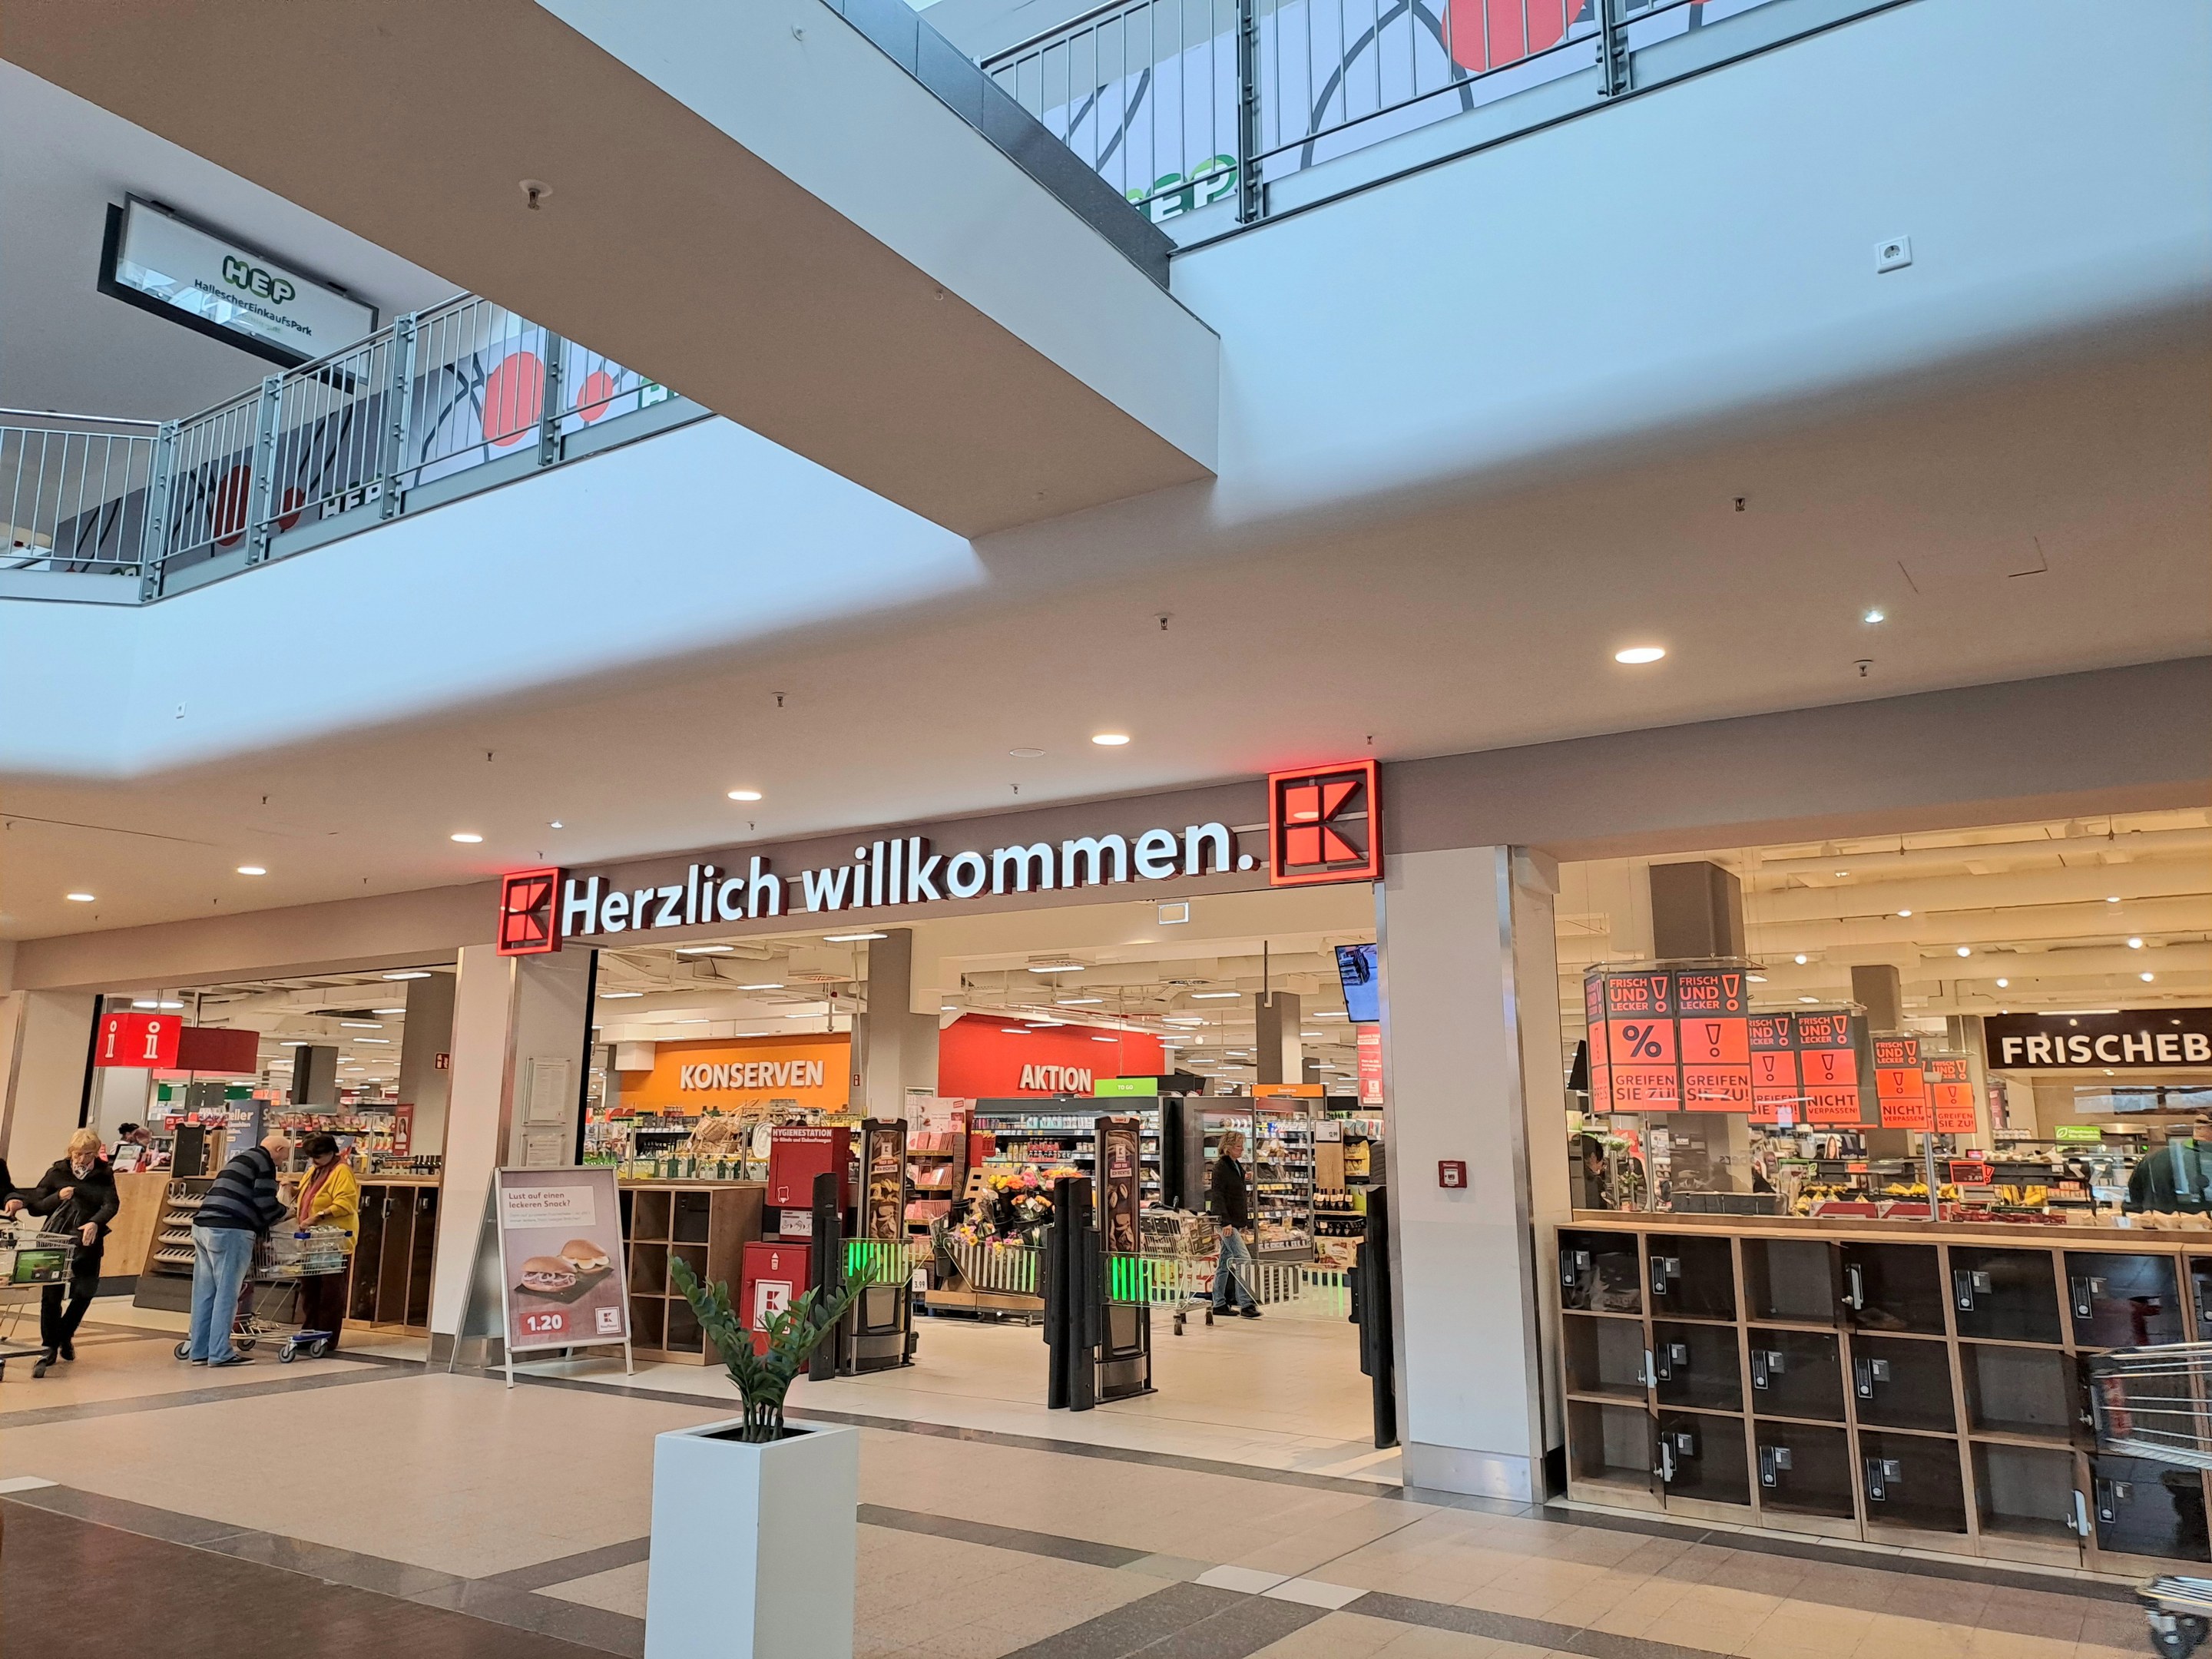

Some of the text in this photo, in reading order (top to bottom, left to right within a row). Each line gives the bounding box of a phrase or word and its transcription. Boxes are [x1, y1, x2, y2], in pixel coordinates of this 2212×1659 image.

[1129, 162, 1233, 224] EP
[223, 256, 296, 304] HEP
[561, 821, 1255, 937] Herzlich willkommen.
[1609, 978, 1647, 988] FRISCH
[1679, 976, 1718, 986] FRISCH
[1610, 988, 1648, 1002] UND
[1680, 986, 1719, 1001] UND
[1611, 1002, 1649, 1012] LECKER
[1681, 1000, 1720, 1010] LECKER
[1799, 1017, 1830, 1025] FRISCH
[1800, 1025, 1832, 1036] UND
[1800, 1036, 1833, 1045] LECKER
[1876, 1048, 1904, 1058] UND
[2001, 1033, 2212, 1065] FRISCHEB
[680, 1060, 824, 1091] KONSERVEN
[1019, 1064, 1091, 1092] AKTION
[1616, 1075, 1674, 1086] GREIFEN
[1687, 1075, 1748, 1086] GREIFEN
[1617, 1088, 1642, 1101] SIE
[1687, 1088, 1750, 1101] SIE ZU!
[1754, 1094, 1796, 1103] REIFEN
[1807, 1094, 1856, 1107] NICHT
[1883, 1105, 1923, 1115] NICHT
[527, 1314, 563, 1331] 1.20
